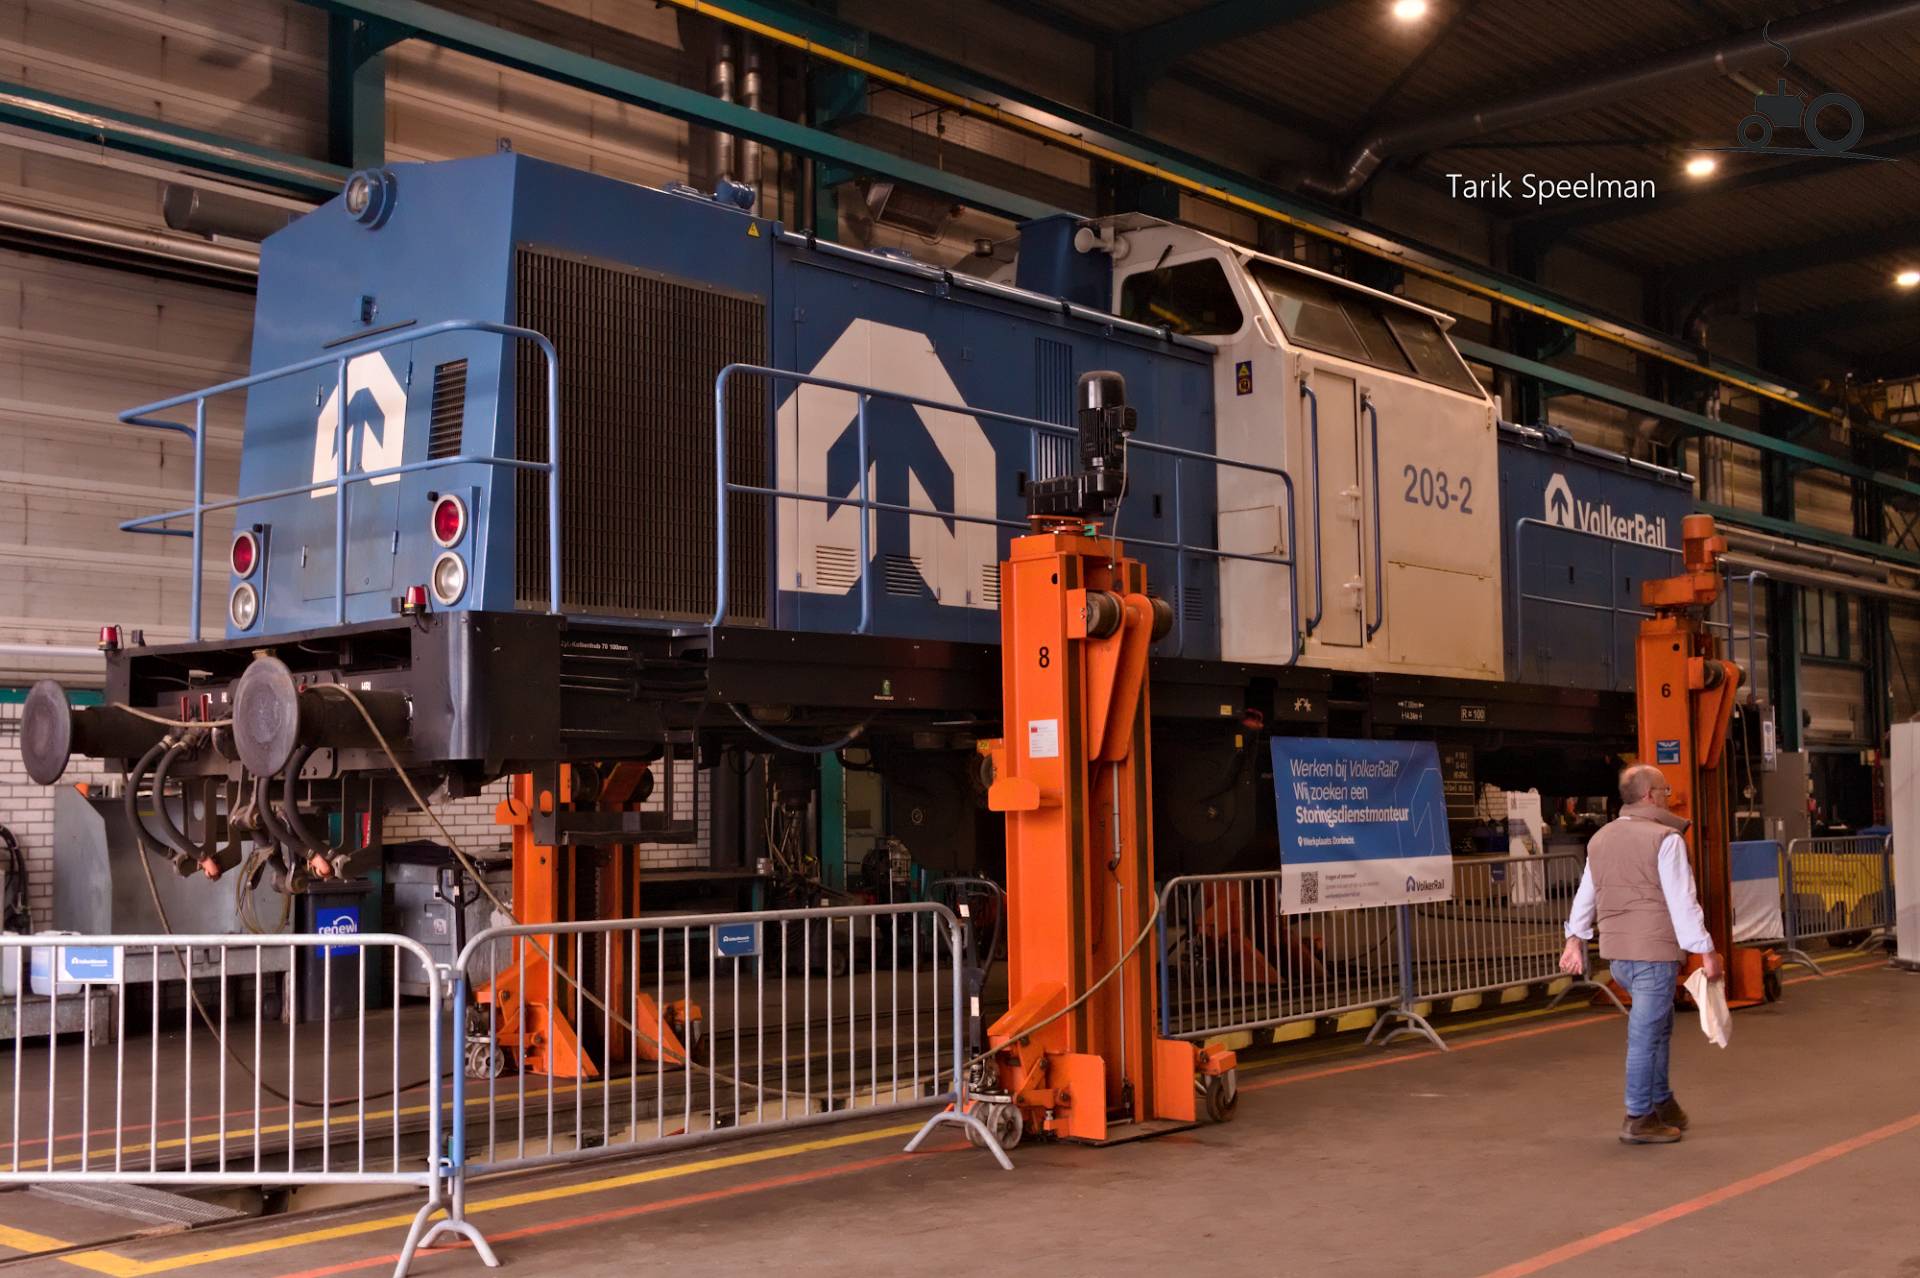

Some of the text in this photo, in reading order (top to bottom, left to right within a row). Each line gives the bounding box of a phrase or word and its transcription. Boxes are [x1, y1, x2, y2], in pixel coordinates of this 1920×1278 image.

[1403, 463, 1473, 515] 203-2
[1577, 499, 1667, 549] VolkerRail
[1039, 646, 1050, 668] 8
[1661, 683, 1672, 699] 6
[1290, 758, 1400, 781] Werken bij VolkerRail?
[1293, 781, 1368, 804] Wij zoeken een
[1295, 805, 1410, 828] Storingsdienstmonteur
[1415, 879, 1446, 892] VolkerRail
